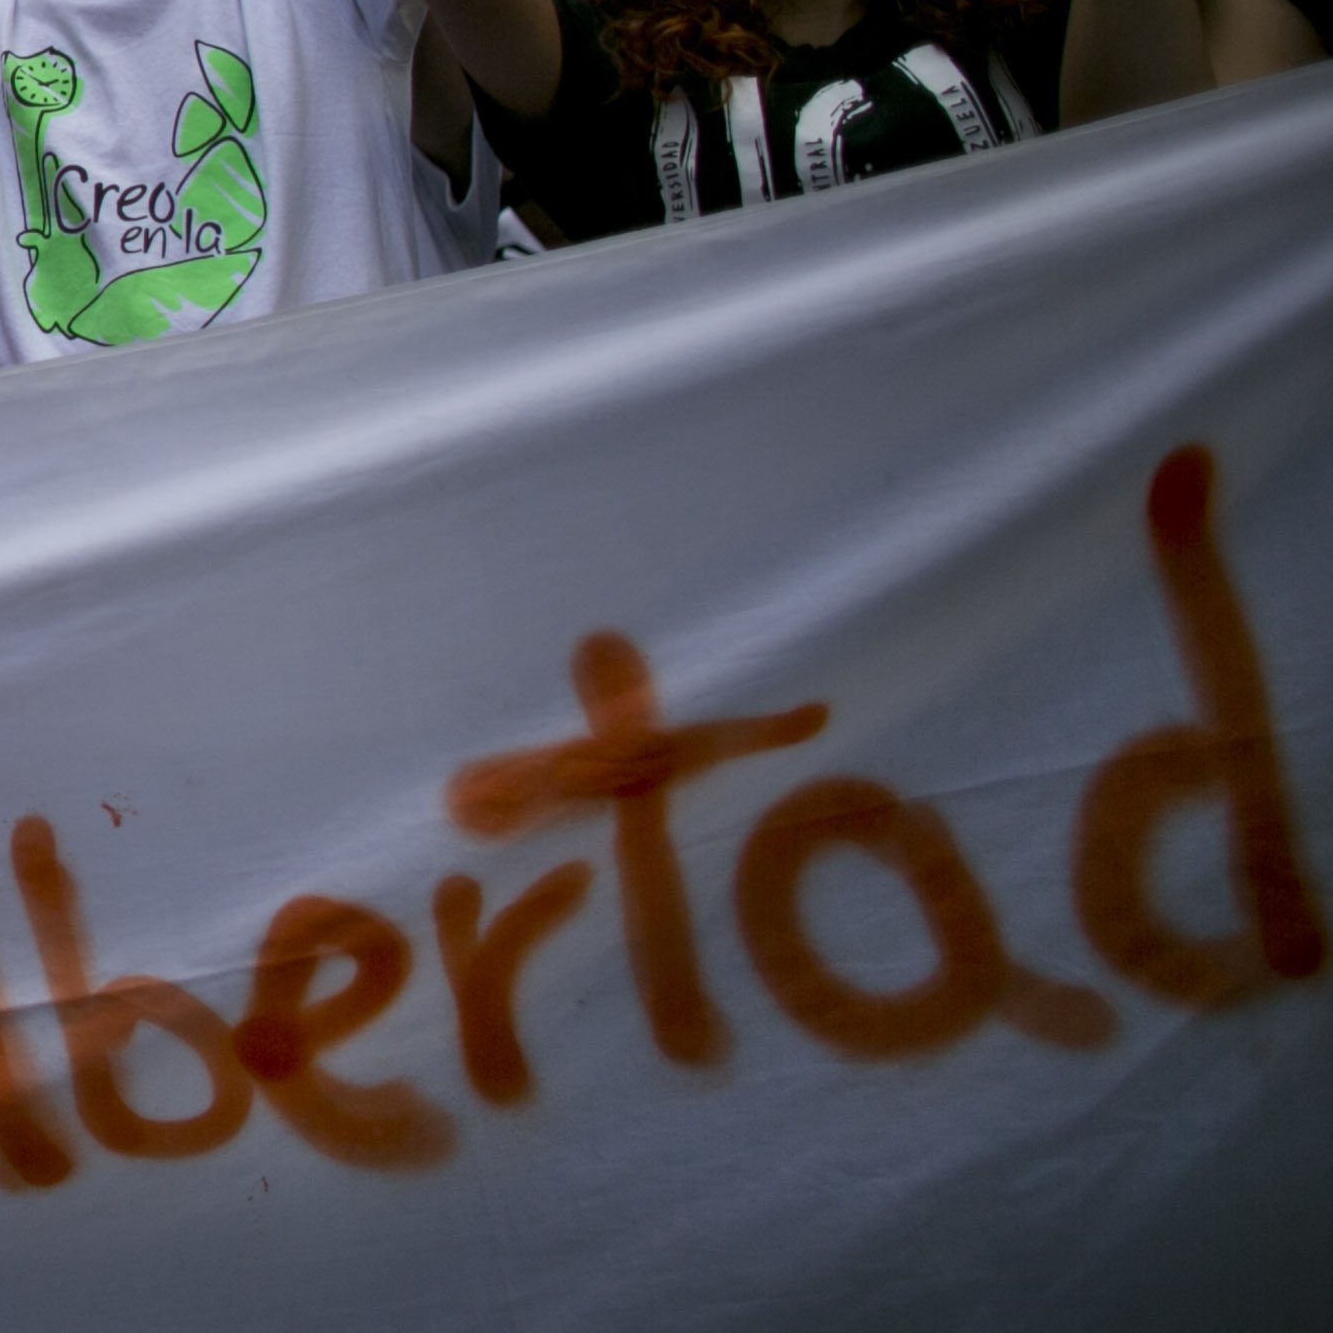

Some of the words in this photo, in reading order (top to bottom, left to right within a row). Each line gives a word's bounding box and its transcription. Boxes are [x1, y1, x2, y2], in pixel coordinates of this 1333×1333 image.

[54, 164, 176, 234] Creo
[120, 226, 167, 259] en
[185, 208, 222, 255] la
